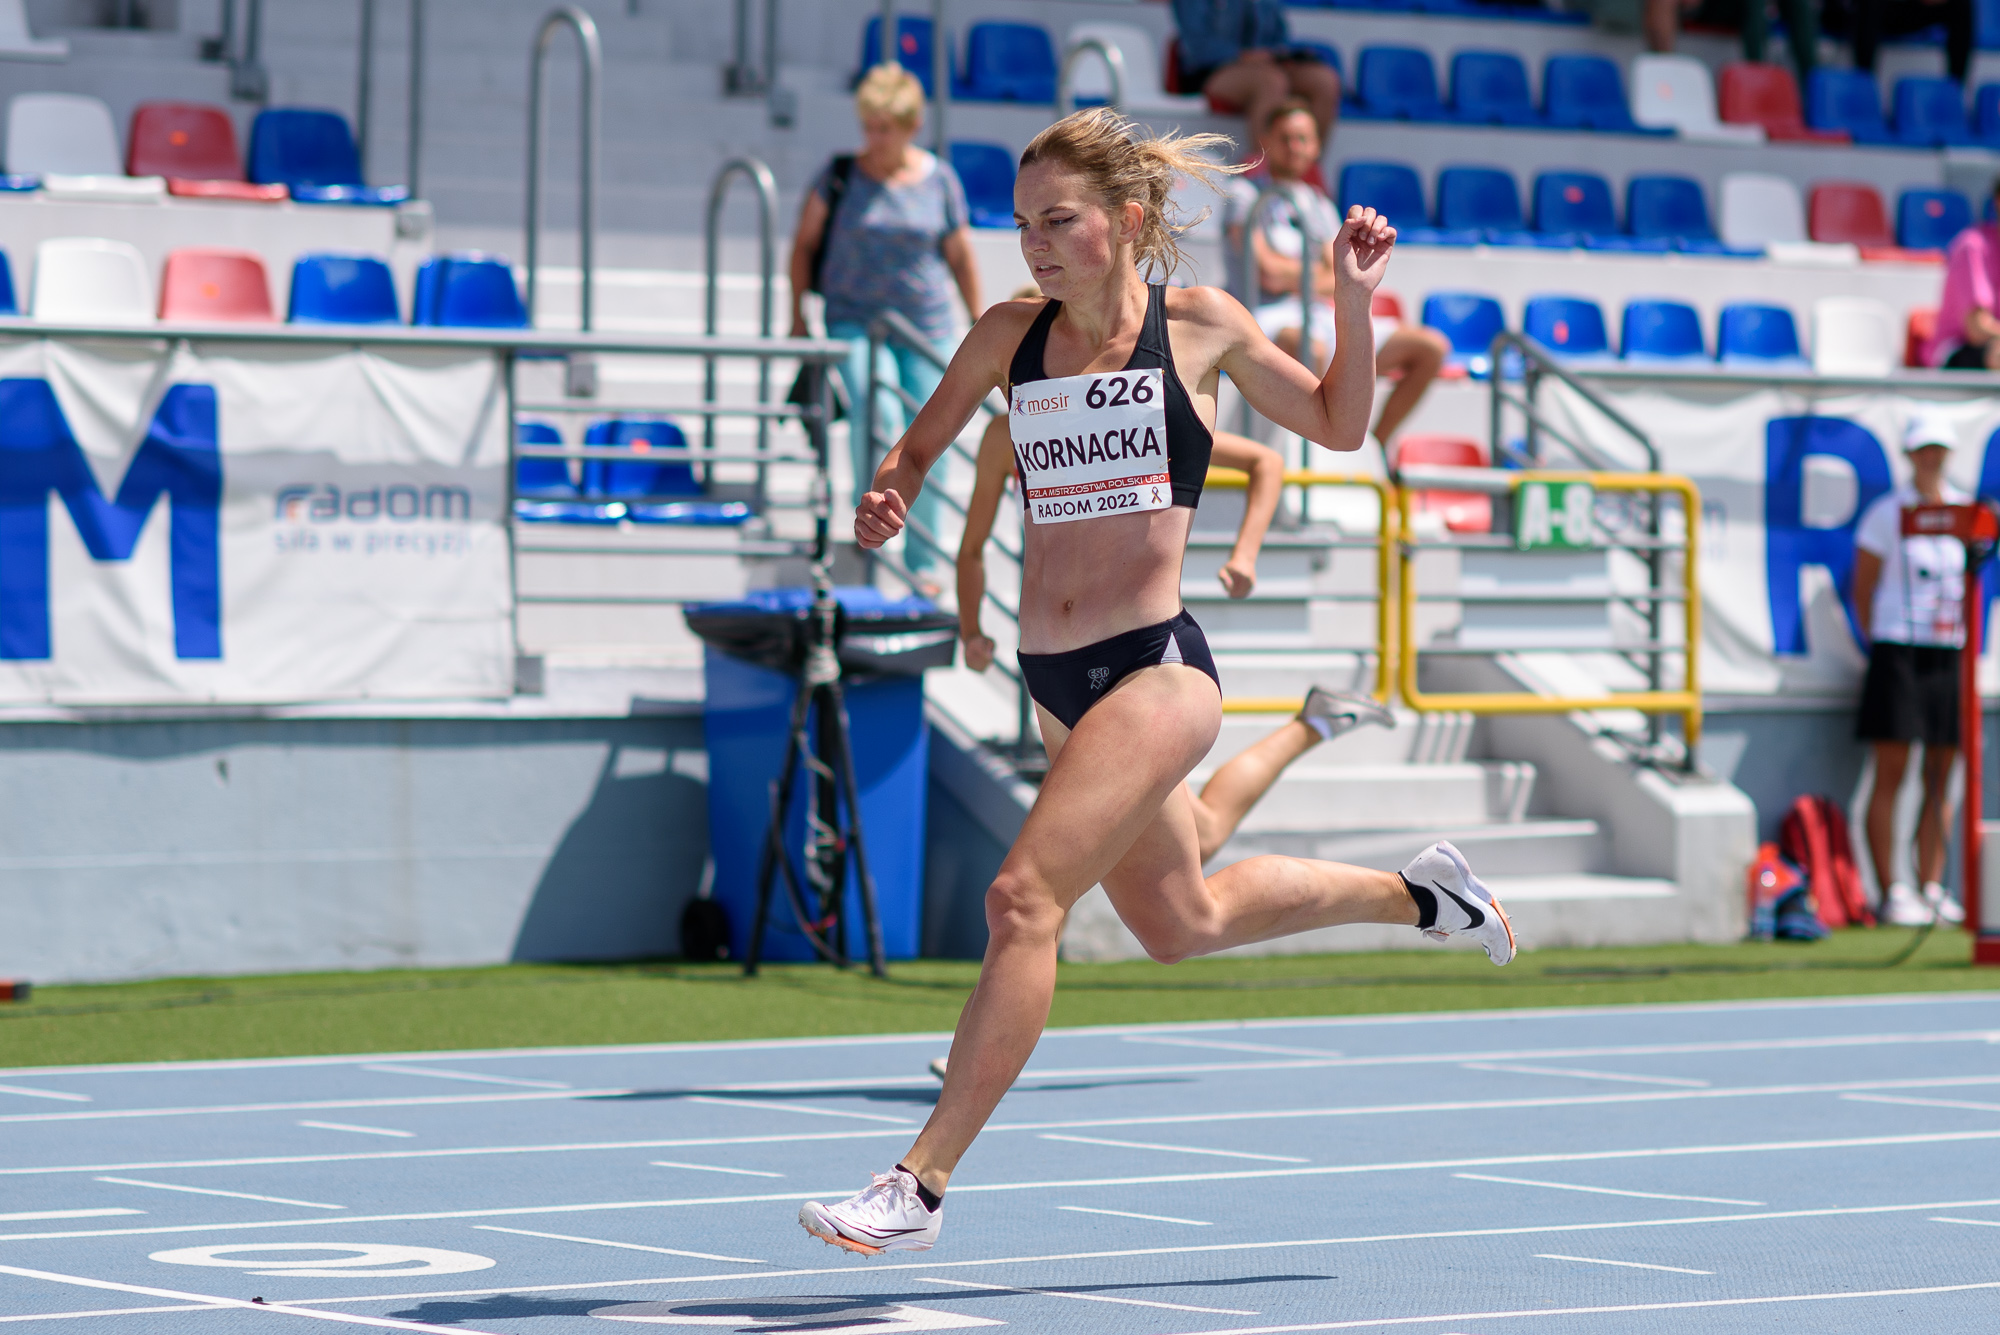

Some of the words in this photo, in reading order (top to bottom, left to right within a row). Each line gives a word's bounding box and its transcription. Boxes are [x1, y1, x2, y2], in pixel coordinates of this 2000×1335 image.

[1027, 392, 1070, 413] mosir
[1085, 375, 1154, 409] 626
[1019, 426, 1162, 472] KORNACKA
[1029, 489, 1048, 498] PZLA
[1048, 482, 1107, 497] MISTRZOSTWA
[1108, 476, 1143, 489] POLSKI
[1145, 474, 1166, 484] U20
[275, 484, 471, 525] radom
[1038, 499, 1093, 519] RADOM
[1097, 492, 1140, 512] 2022
[1523, 483, 1595, 545] A-8
